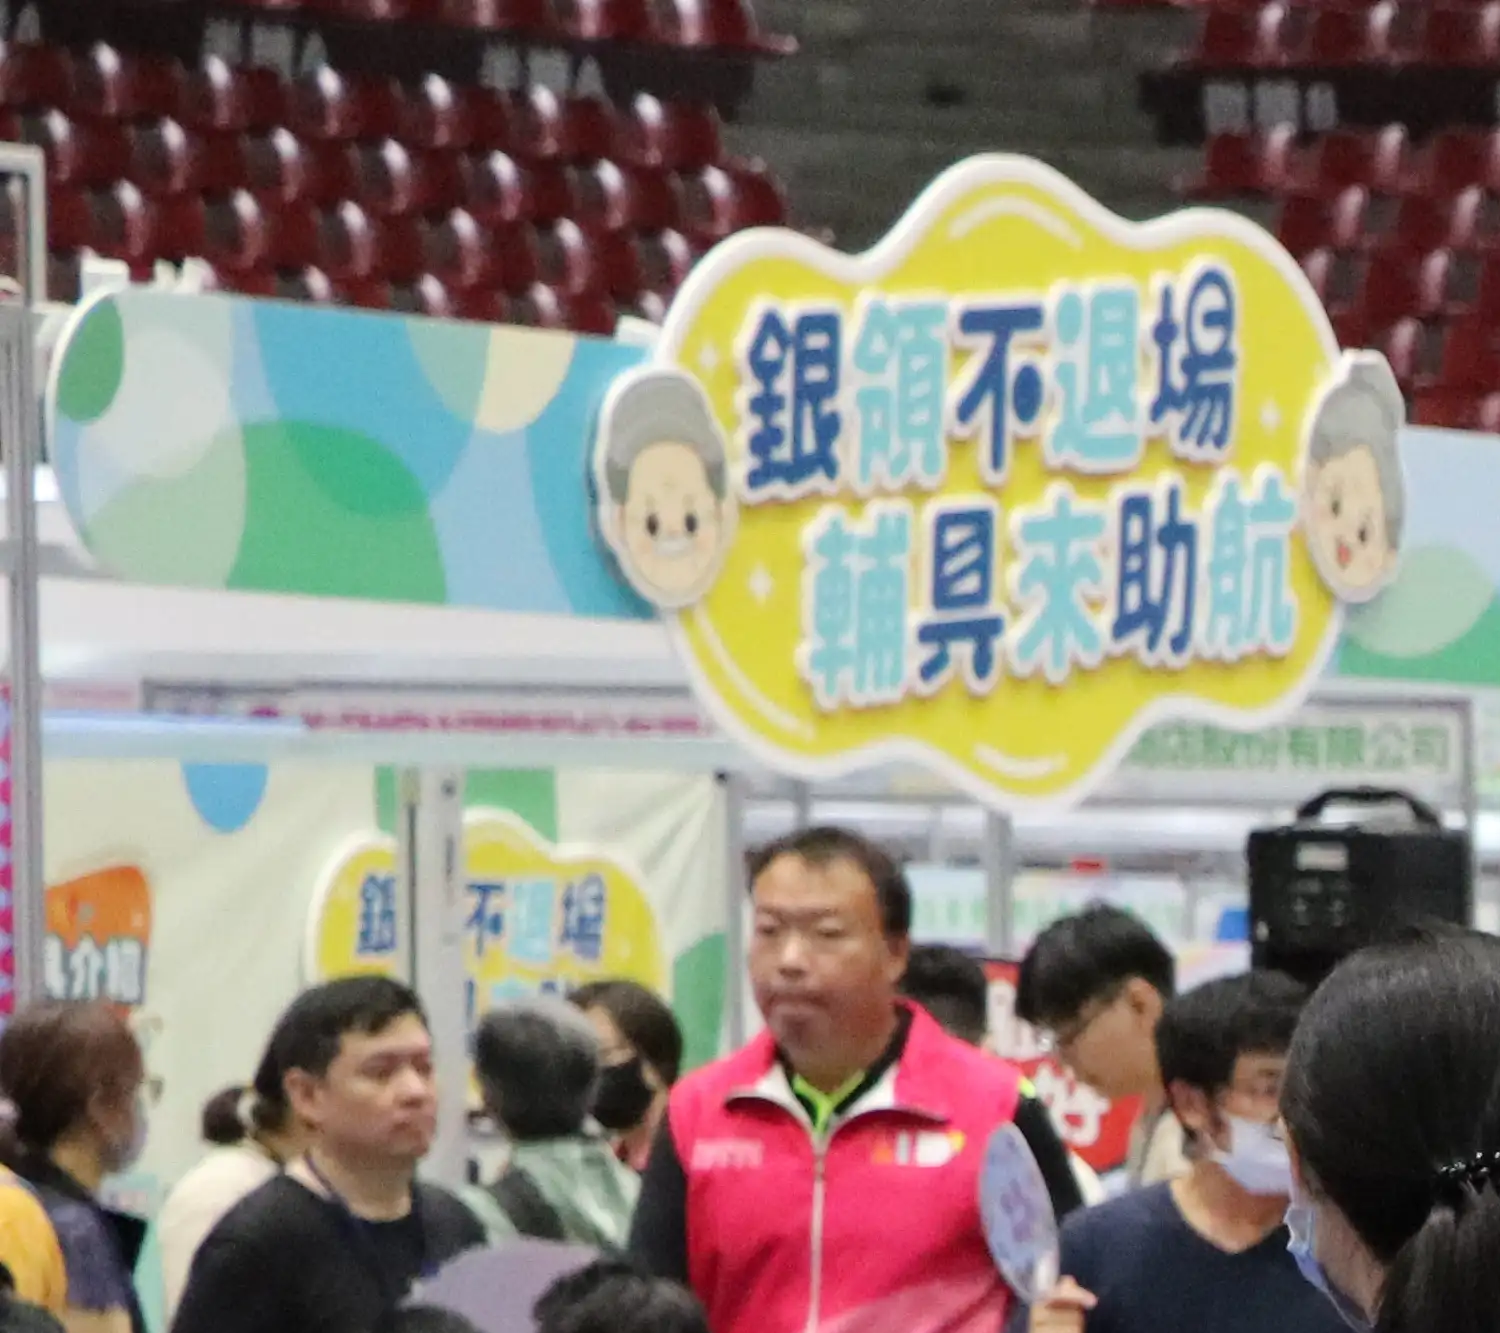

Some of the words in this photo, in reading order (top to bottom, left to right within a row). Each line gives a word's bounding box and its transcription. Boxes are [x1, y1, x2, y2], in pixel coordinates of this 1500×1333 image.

[747, 262, 1238, 492] 銀領不退場
[809, 470, 1296, 704] 輔具來助航
[358, 873, 606, 960] 銀不退場
